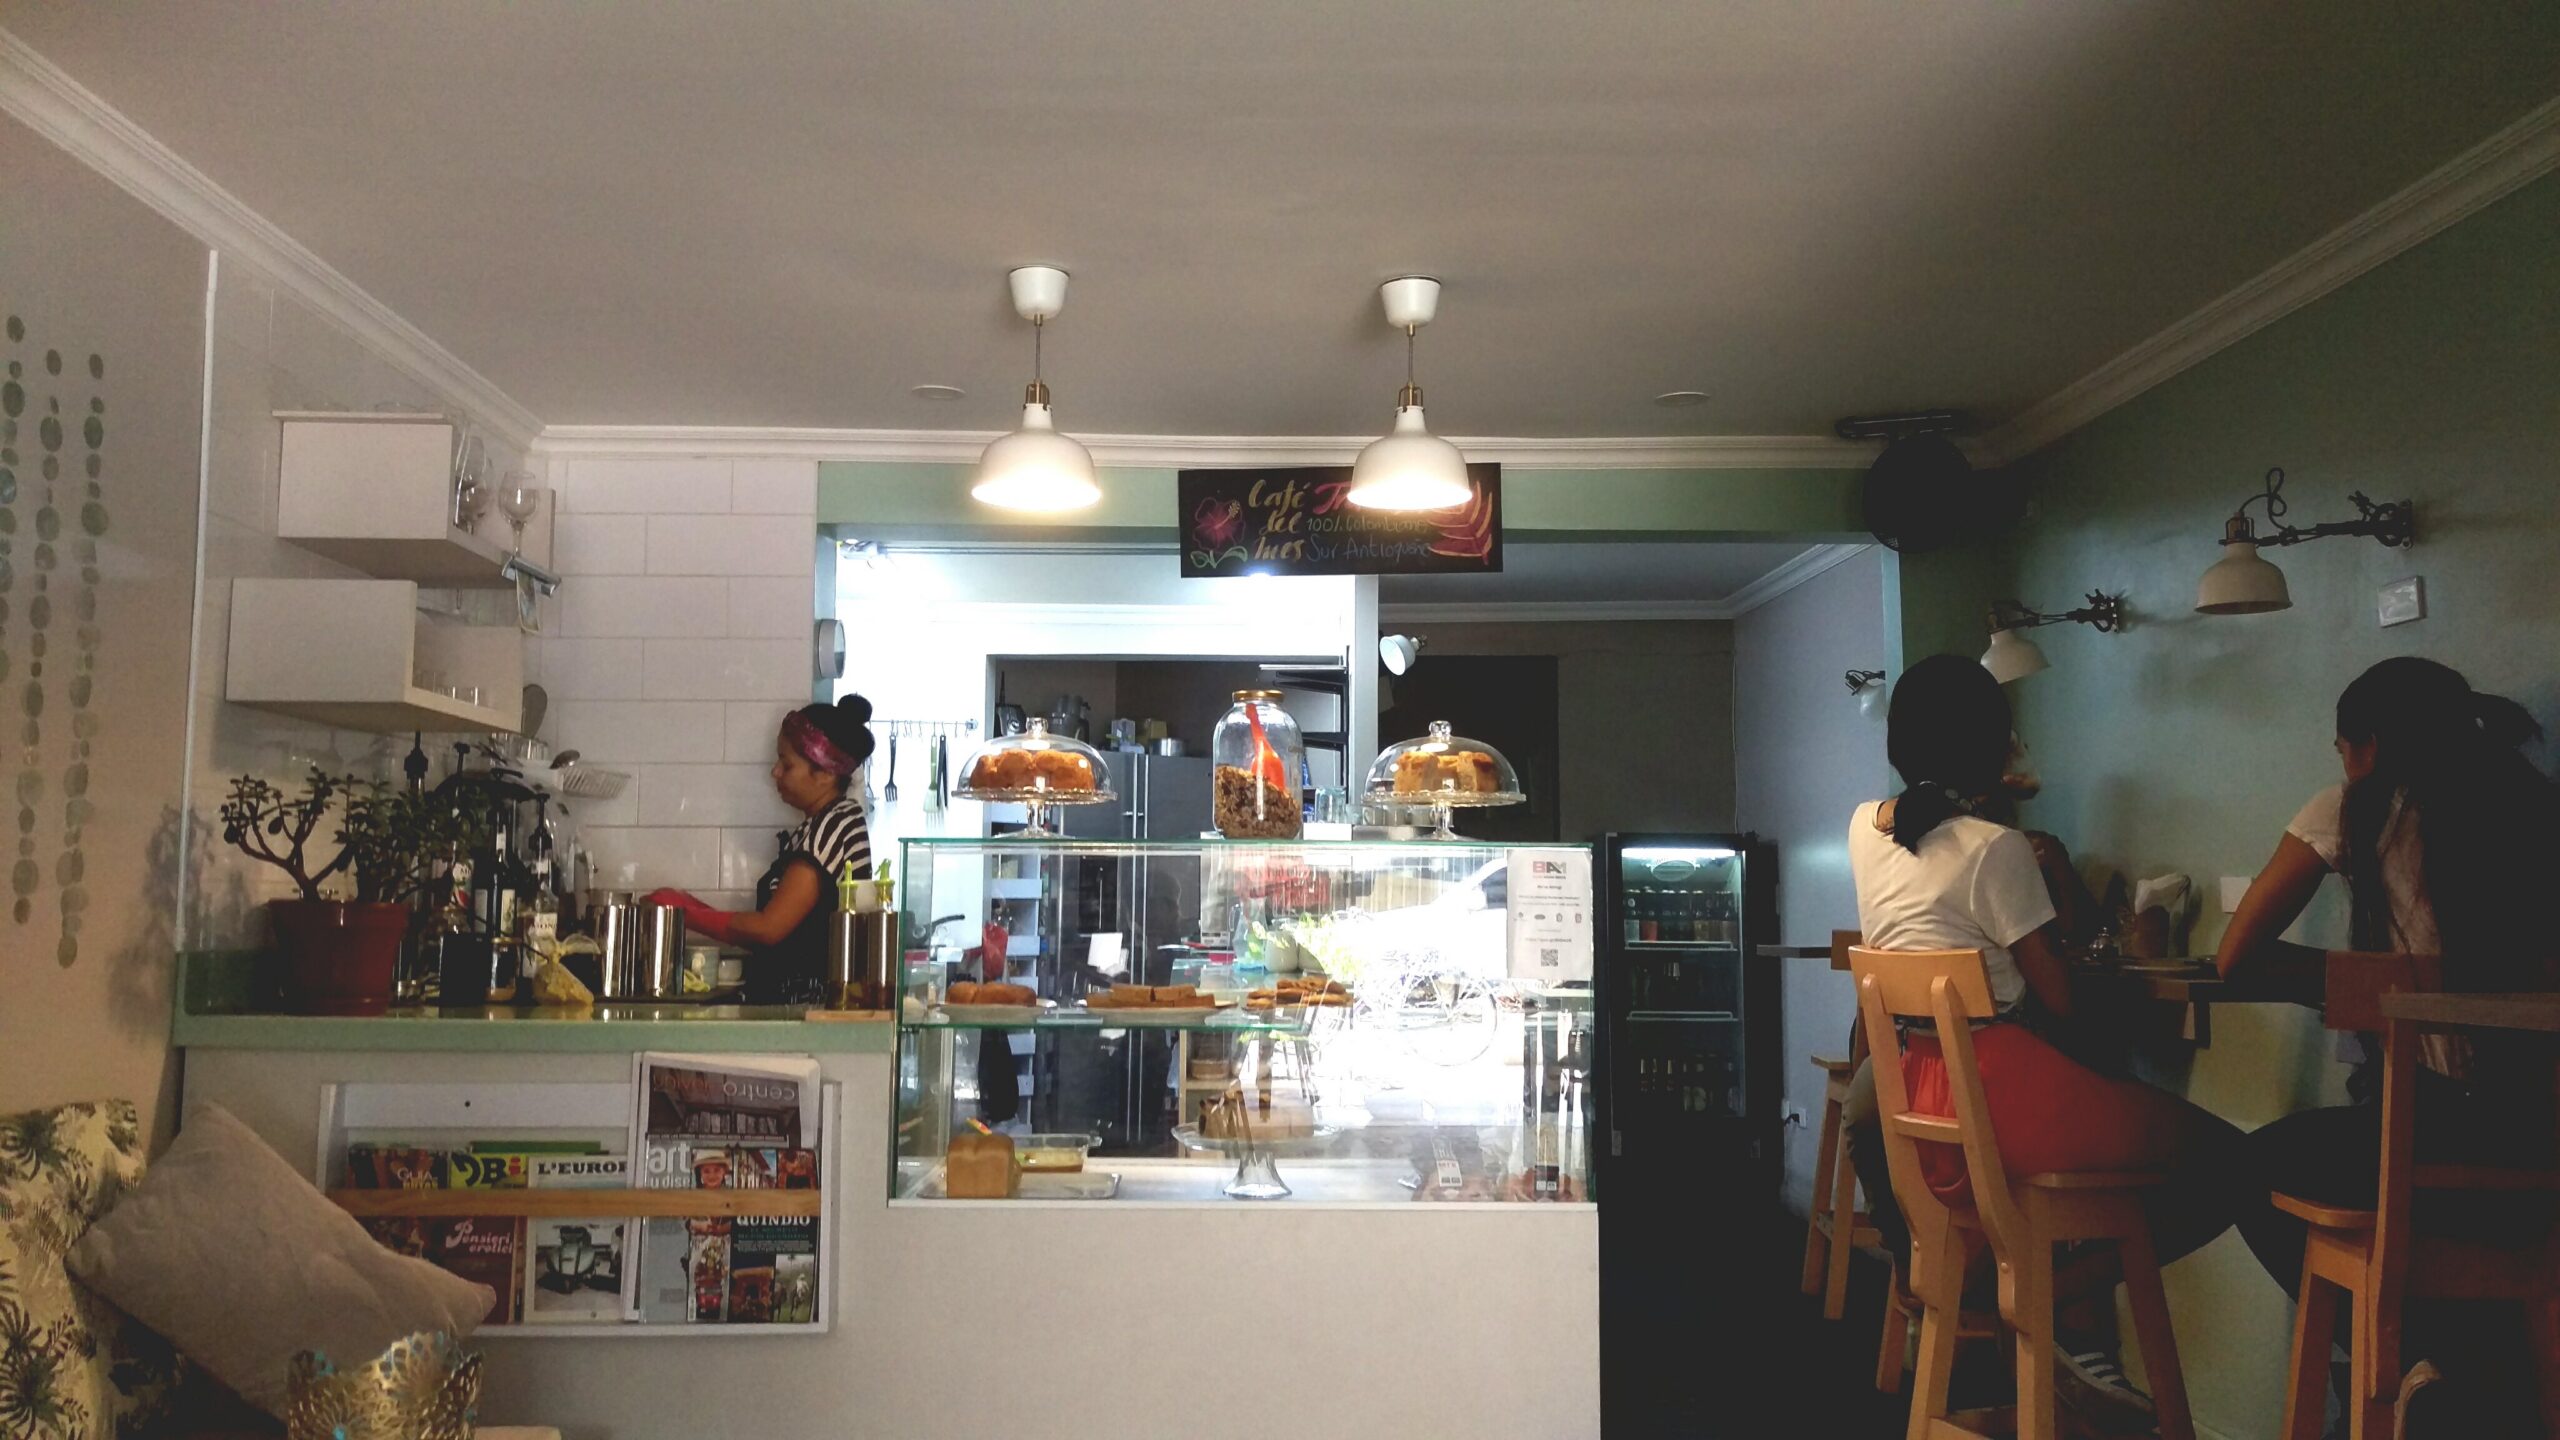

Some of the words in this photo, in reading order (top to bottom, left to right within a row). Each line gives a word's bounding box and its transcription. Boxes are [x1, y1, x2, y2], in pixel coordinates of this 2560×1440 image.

[1248, 479, 1311, 517] Café
[1306, 533, 1339, 562] Sur
[723, 1081, 796, 1102] centro
